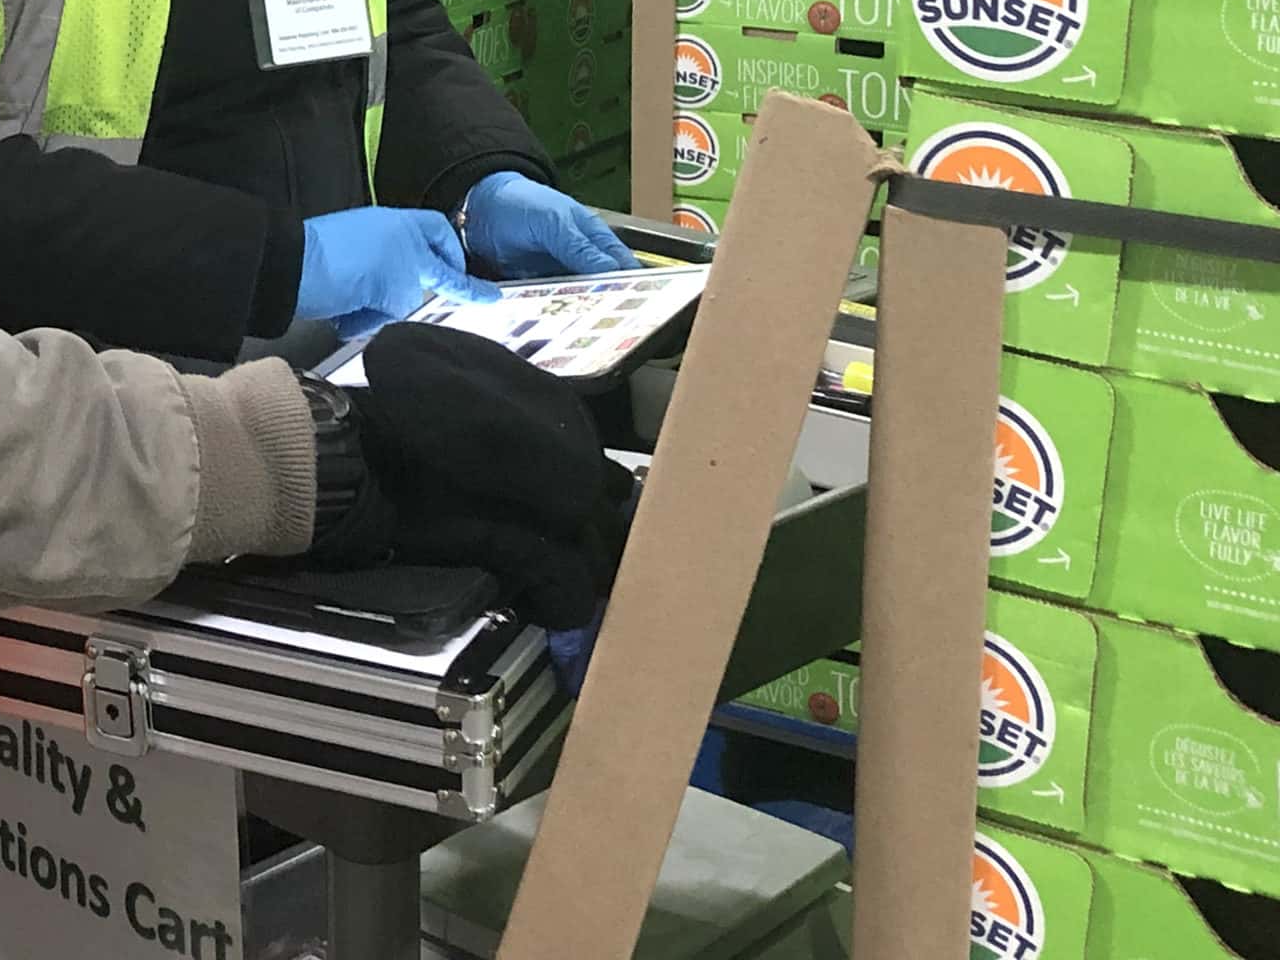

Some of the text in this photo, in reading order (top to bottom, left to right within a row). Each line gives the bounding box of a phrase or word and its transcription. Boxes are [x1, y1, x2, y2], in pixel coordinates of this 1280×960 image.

[676, 70, 719, 92] NSET
[737, 58, 820, 90] INSPIRED
[673, 147, 717, 169] NSET
[991, 477, 1056, 528] SET
[1200, 499, 1267, 533] LIVE LIFE
[1203, 518, 1262, 551] FLAVOR
[1209, 540, 1253, 567] FULLY
[977, 709, 1047, 761] SET
[106, 764, 146, 832] &
[125, 882, 233, 960] Cart
[970, 909, 1037, 960] SET
